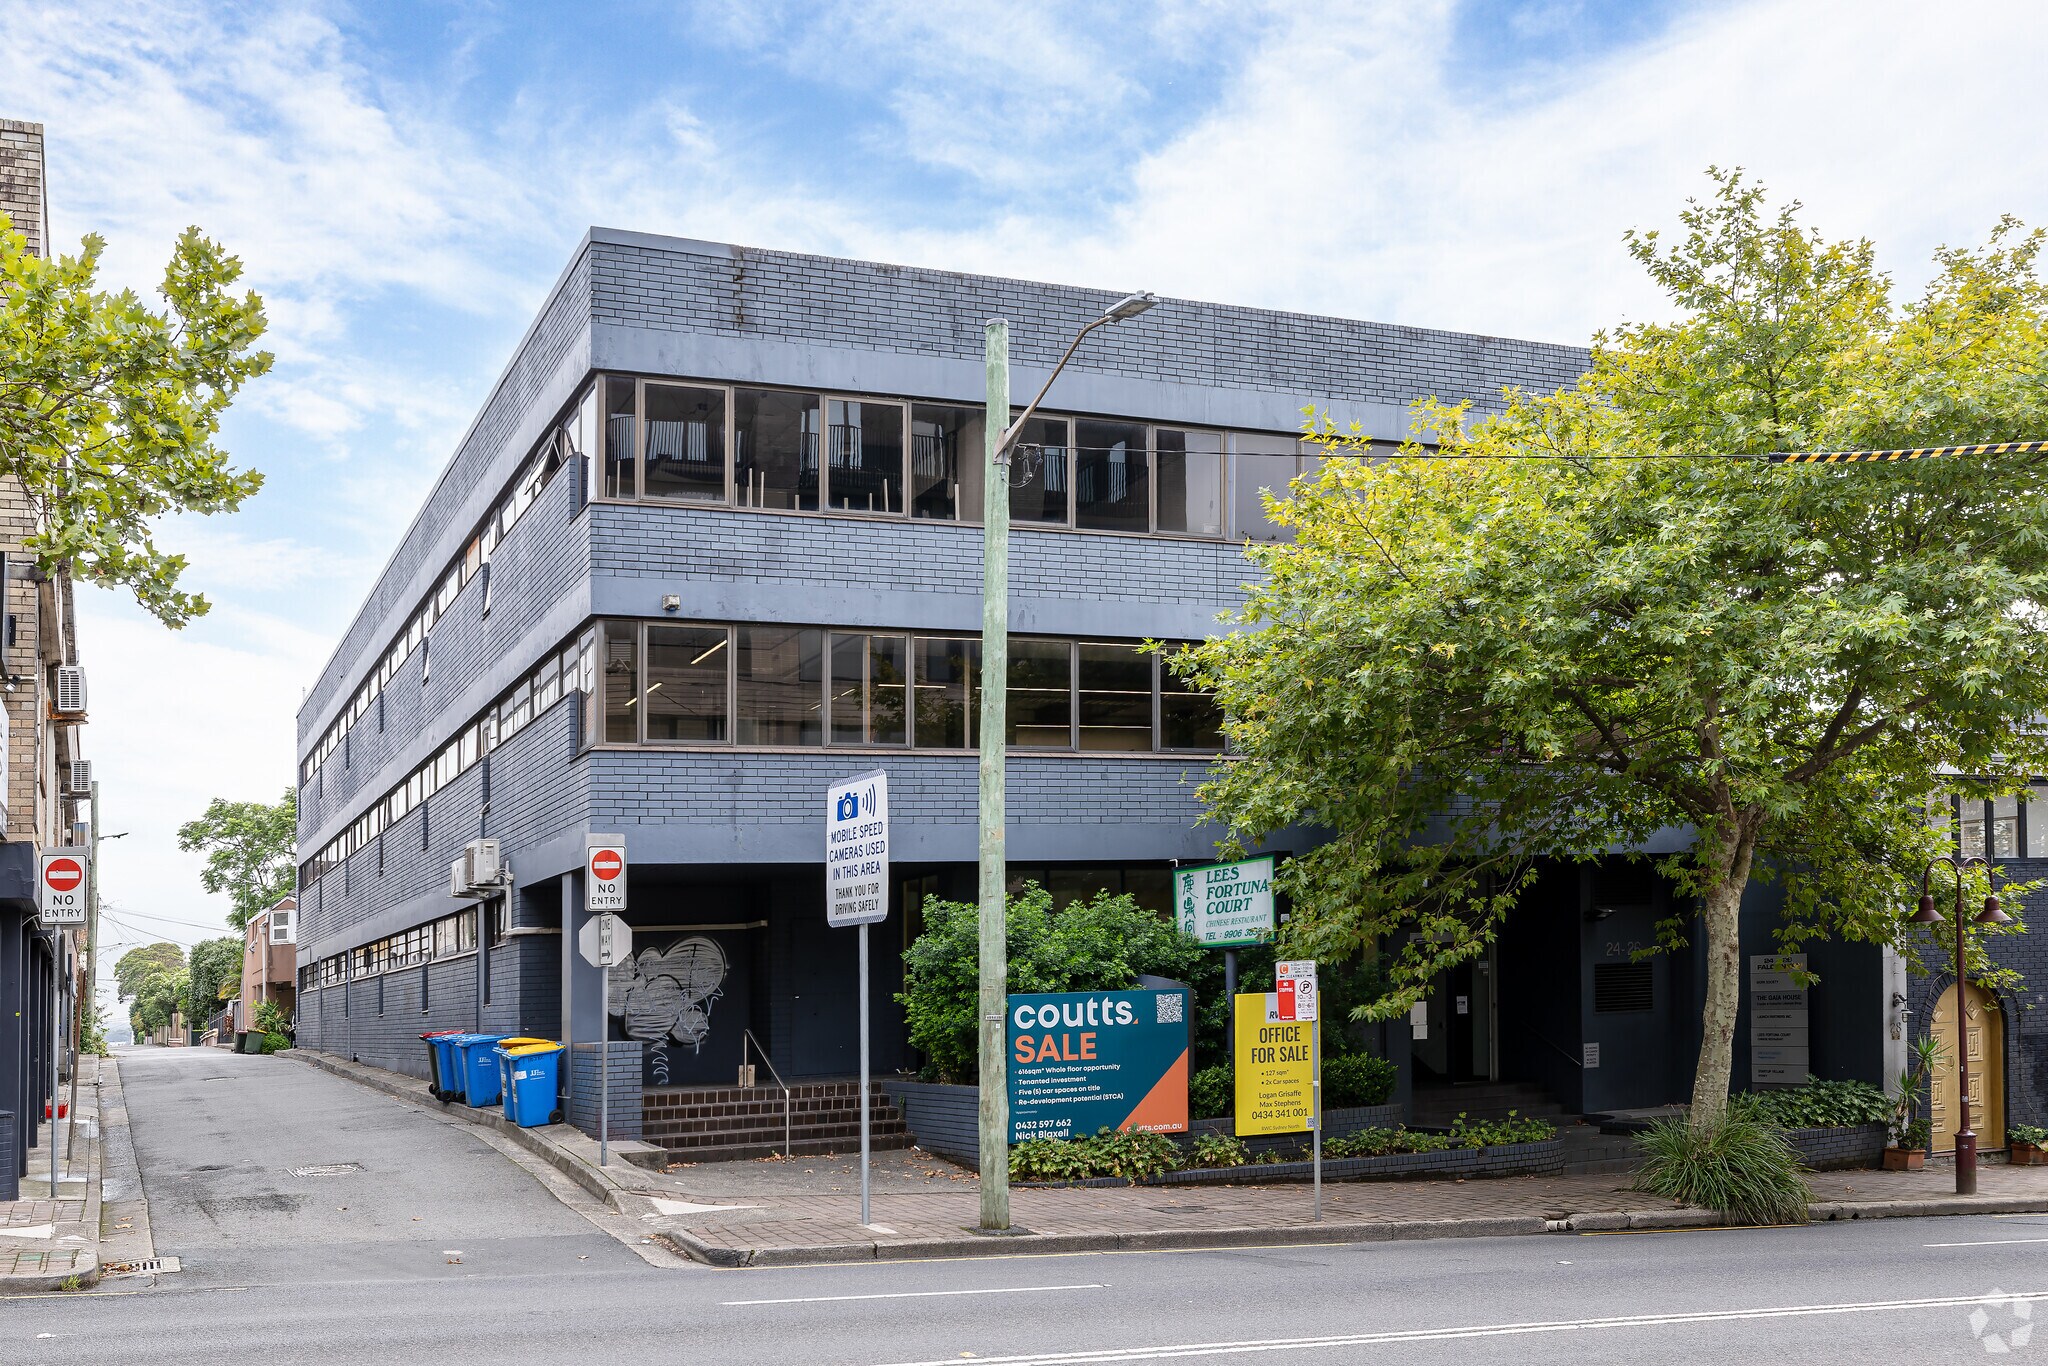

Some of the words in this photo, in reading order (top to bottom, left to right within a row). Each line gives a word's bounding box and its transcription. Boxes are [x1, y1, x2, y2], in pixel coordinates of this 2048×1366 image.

[830, 826, 857, 844] MOBILE
[860, 821, 883, 839] SPEED
[829, 845, 863, 862] CAMERAS
[866, 840, 885, 855] USED
[833, 867, 840, 880] IN
[843, 864, 858, 878] THIS
[860, 861, 880, 876] AREA
[1206, 866, 1240, 884] LEES
[598, 884, 615, 893] NO
[835, 886, 853, 899] THANK
[855, 884, 866, 896] YOU
[868, 882, 879, 894] FOR
[1206, 879, 1268, 900] FORTUNA
[53, 895, 74, 905] NO
[592, 896, 622, 905] ENTRY
[835, 901, 856, 916] DRIVING
[858, 898, 879, 913] SAFELY
[1206, 897, 1252, 915] COURT
[45, 909, 81, 917] ENTRY
[1206, 918, 1230, 928] CHINESE
[1230, 914, 1267, 926] RESTAURANT
[1205, 932, 1216, 940] TEL
[1224, 929, 1242, 939] 9906
[1260, 1026, 1301, 1044] OFFICE
[1015, 1032, 1097, 1063] SALE
[1251, 1047, 1275, 1064] FOR
[1280, 1045, 1308, 1062] SALE
[1083, 1064, 1120, 1072] opportunity
[1018, 1096, 1072, 1105] Re-development
[1073, 1095, 1102, 1103] potential
[1252, 1111, 1273, 1120] 0434
[1276, 1109, 1290, 1118] 341
[1293, 1108, 1308, 1117] 001
[1016, 1121, 1037, 1130] 0432
[1039, 1120, 1054, 1128] 597
[1056, 1119, 1072, 1128] 662
[1126, 1123, 1182, 1132] cutts.com.au
[1016, 1130, 1037, 1140] Nick
[1038, 1129, 1069, 1139] Blaxell
